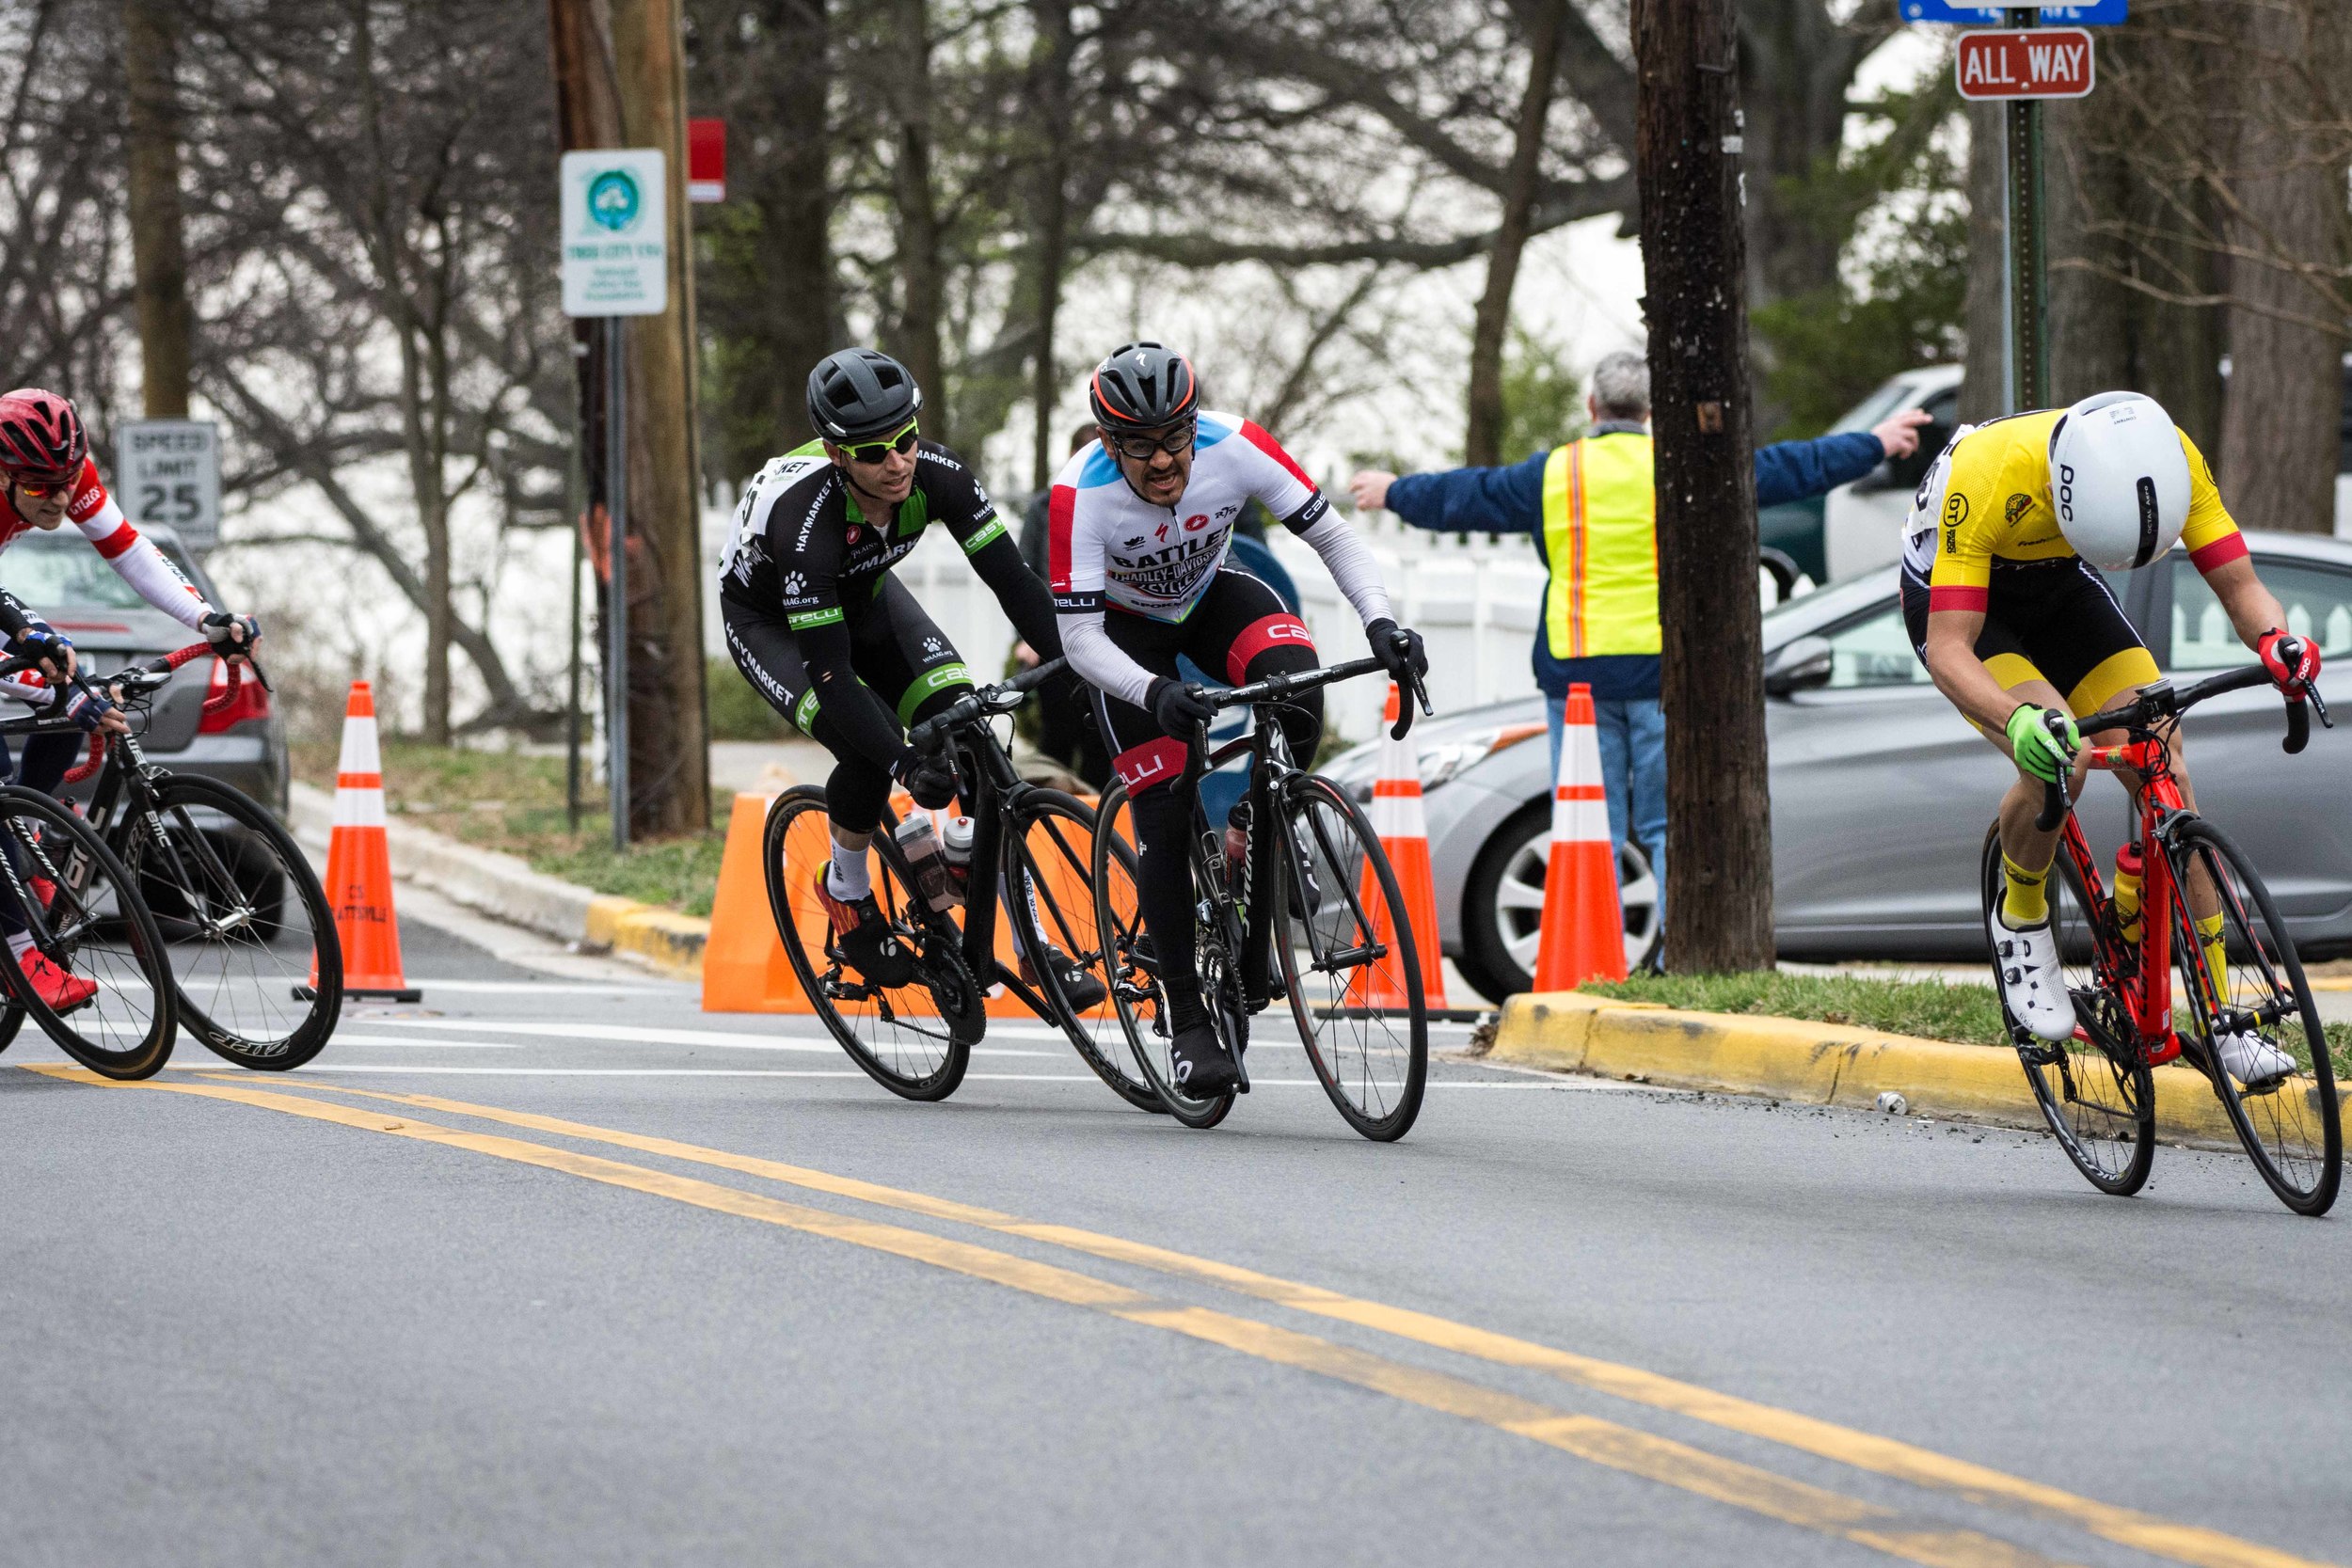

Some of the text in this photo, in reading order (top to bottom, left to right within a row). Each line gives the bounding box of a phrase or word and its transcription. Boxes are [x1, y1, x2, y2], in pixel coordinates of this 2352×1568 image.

[1964, 43, 2085, 85] ALL WAY
[133, 433, 208, 451] SPEED
[137, 458, 197, 478] LIMIT
[140, 483, 202, 522] 25
[795, 478, 833, 552] HAYMARKET
[1947, 498, 1961, 522] DT
[725, 622, 795, 706] HAYMARKET
[145, 810, 172, 848] BMC
